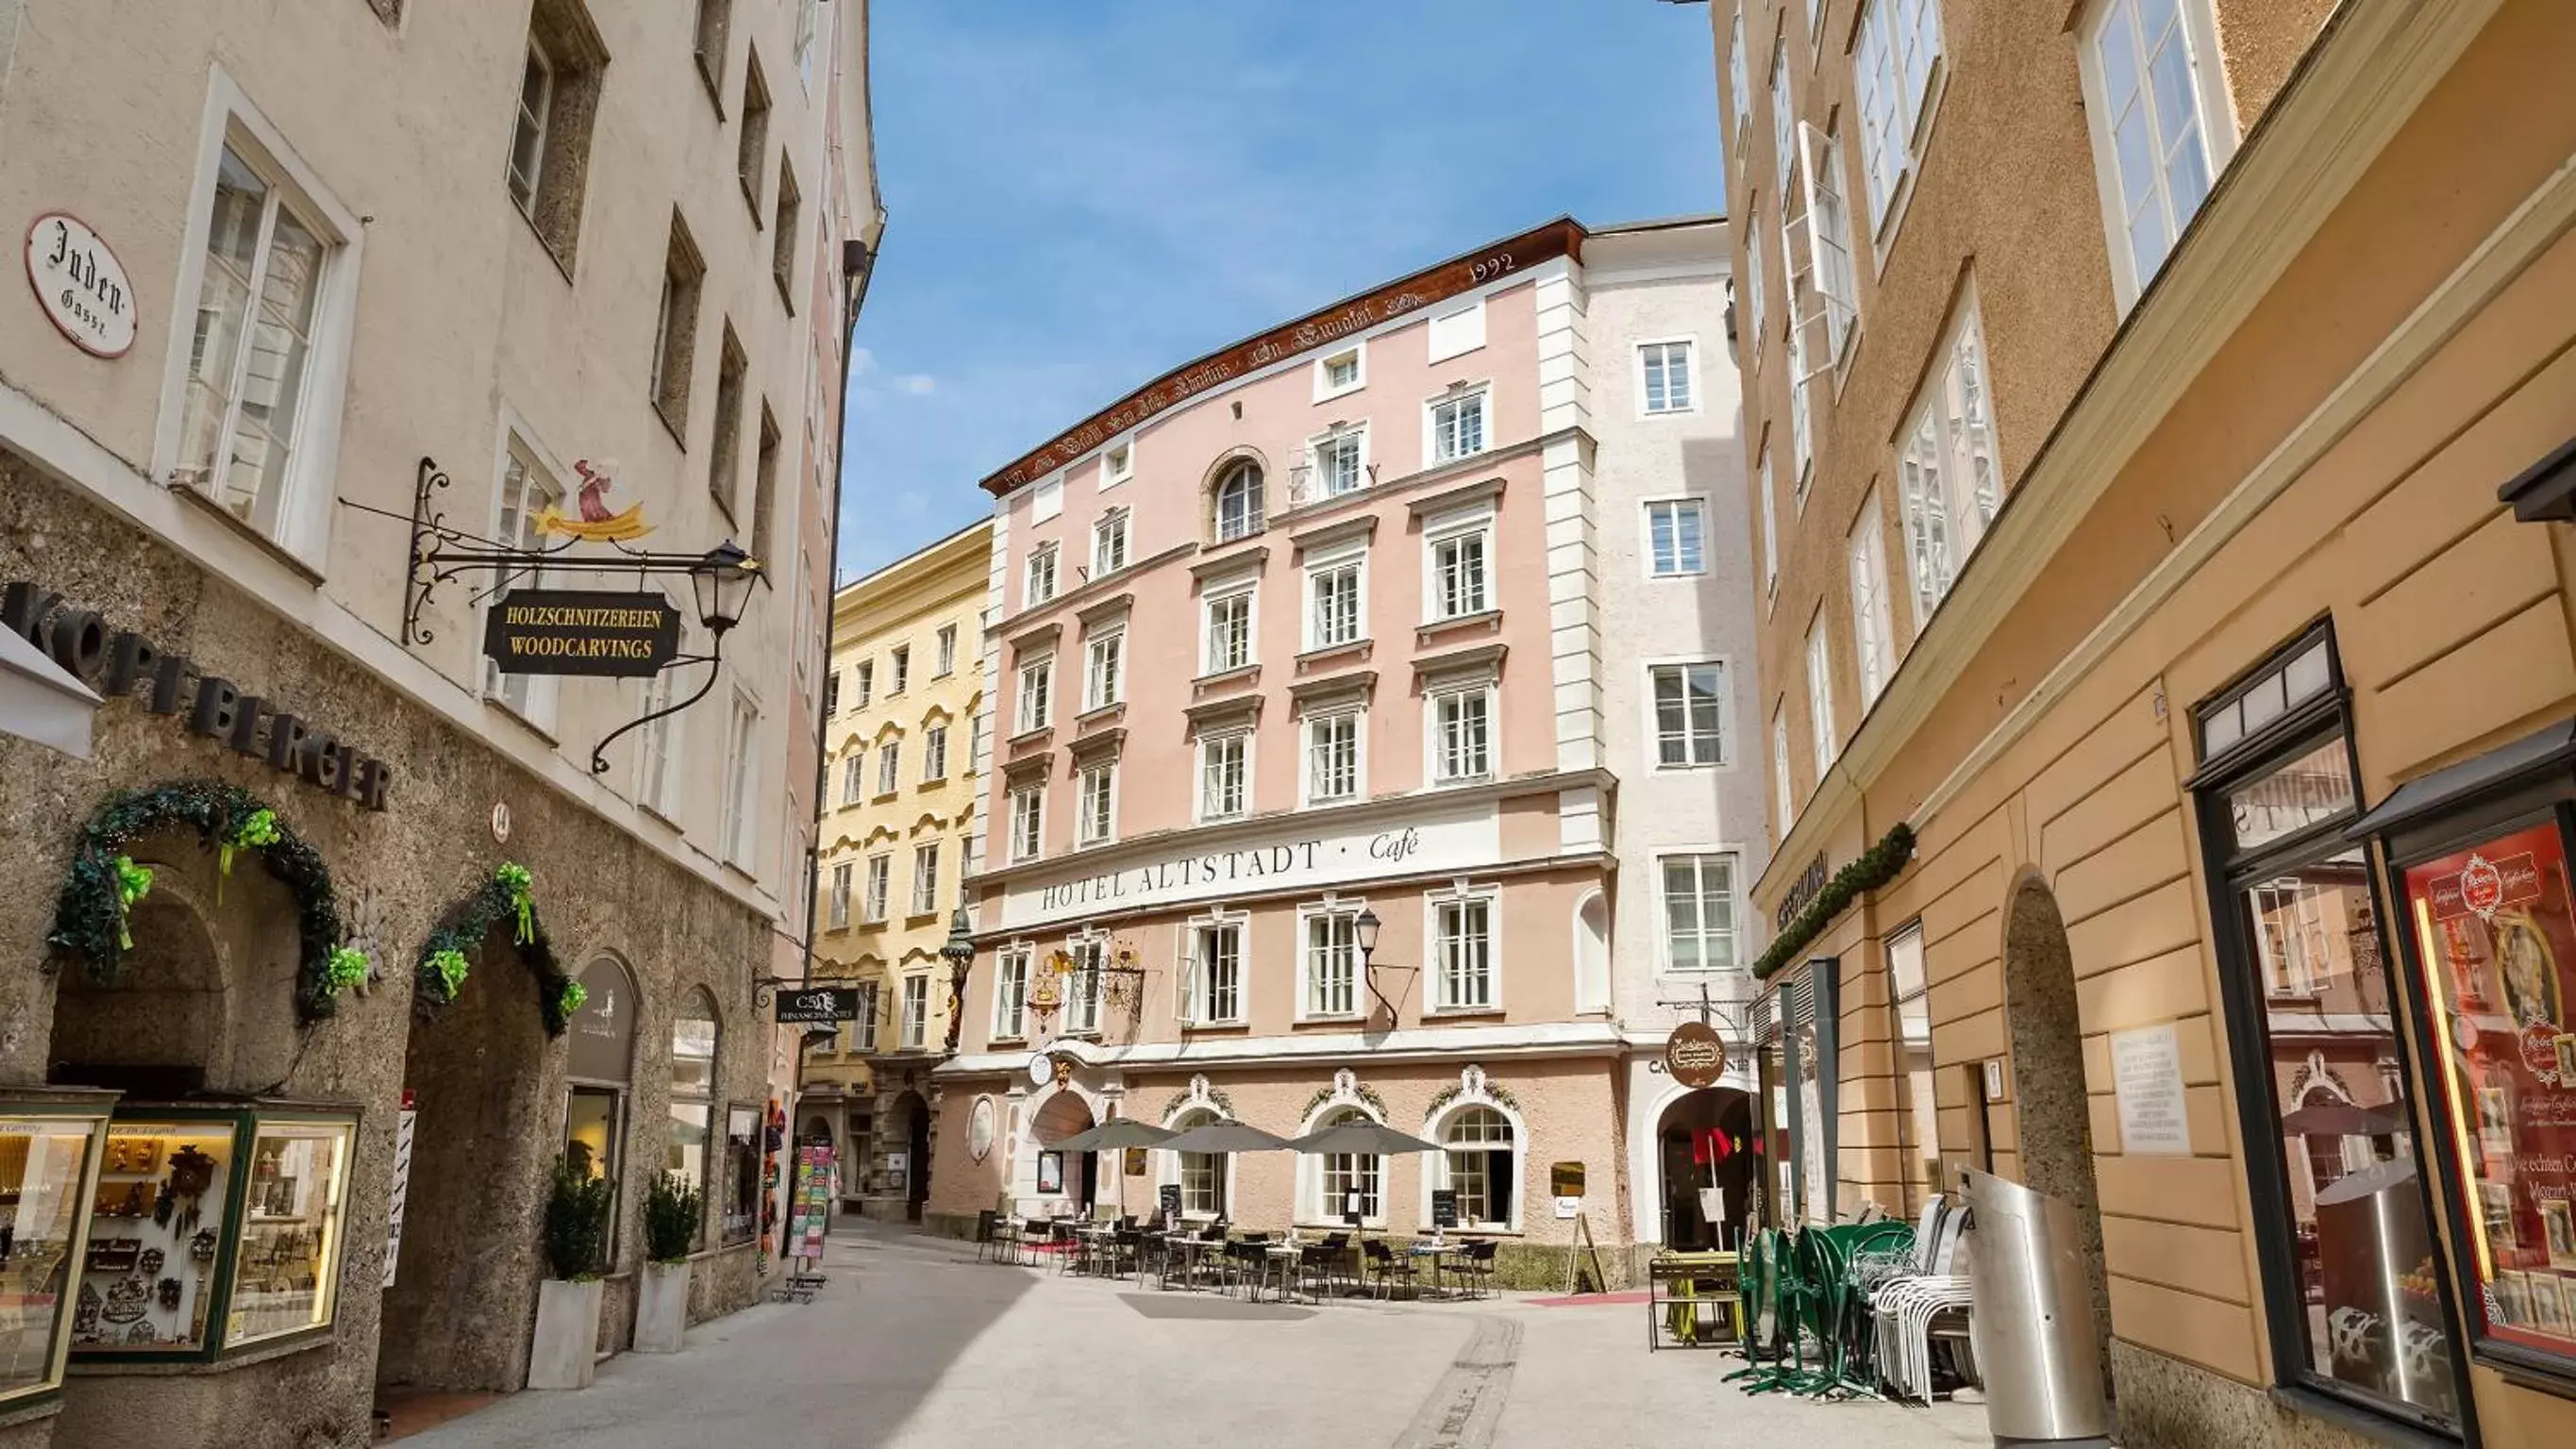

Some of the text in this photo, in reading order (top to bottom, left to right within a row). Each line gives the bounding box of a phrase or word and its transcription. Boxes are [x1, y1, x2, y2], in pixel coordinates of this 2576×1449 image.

[1469, 253, 1514, 283] 1992
[506, 607, 662, 629] HOLZSCHNITZEREIEN
[510, 636, 652, 658] WOODCARVINGS
[1043, 826, 1419, 909] HOTEL ALTSTADT Café
